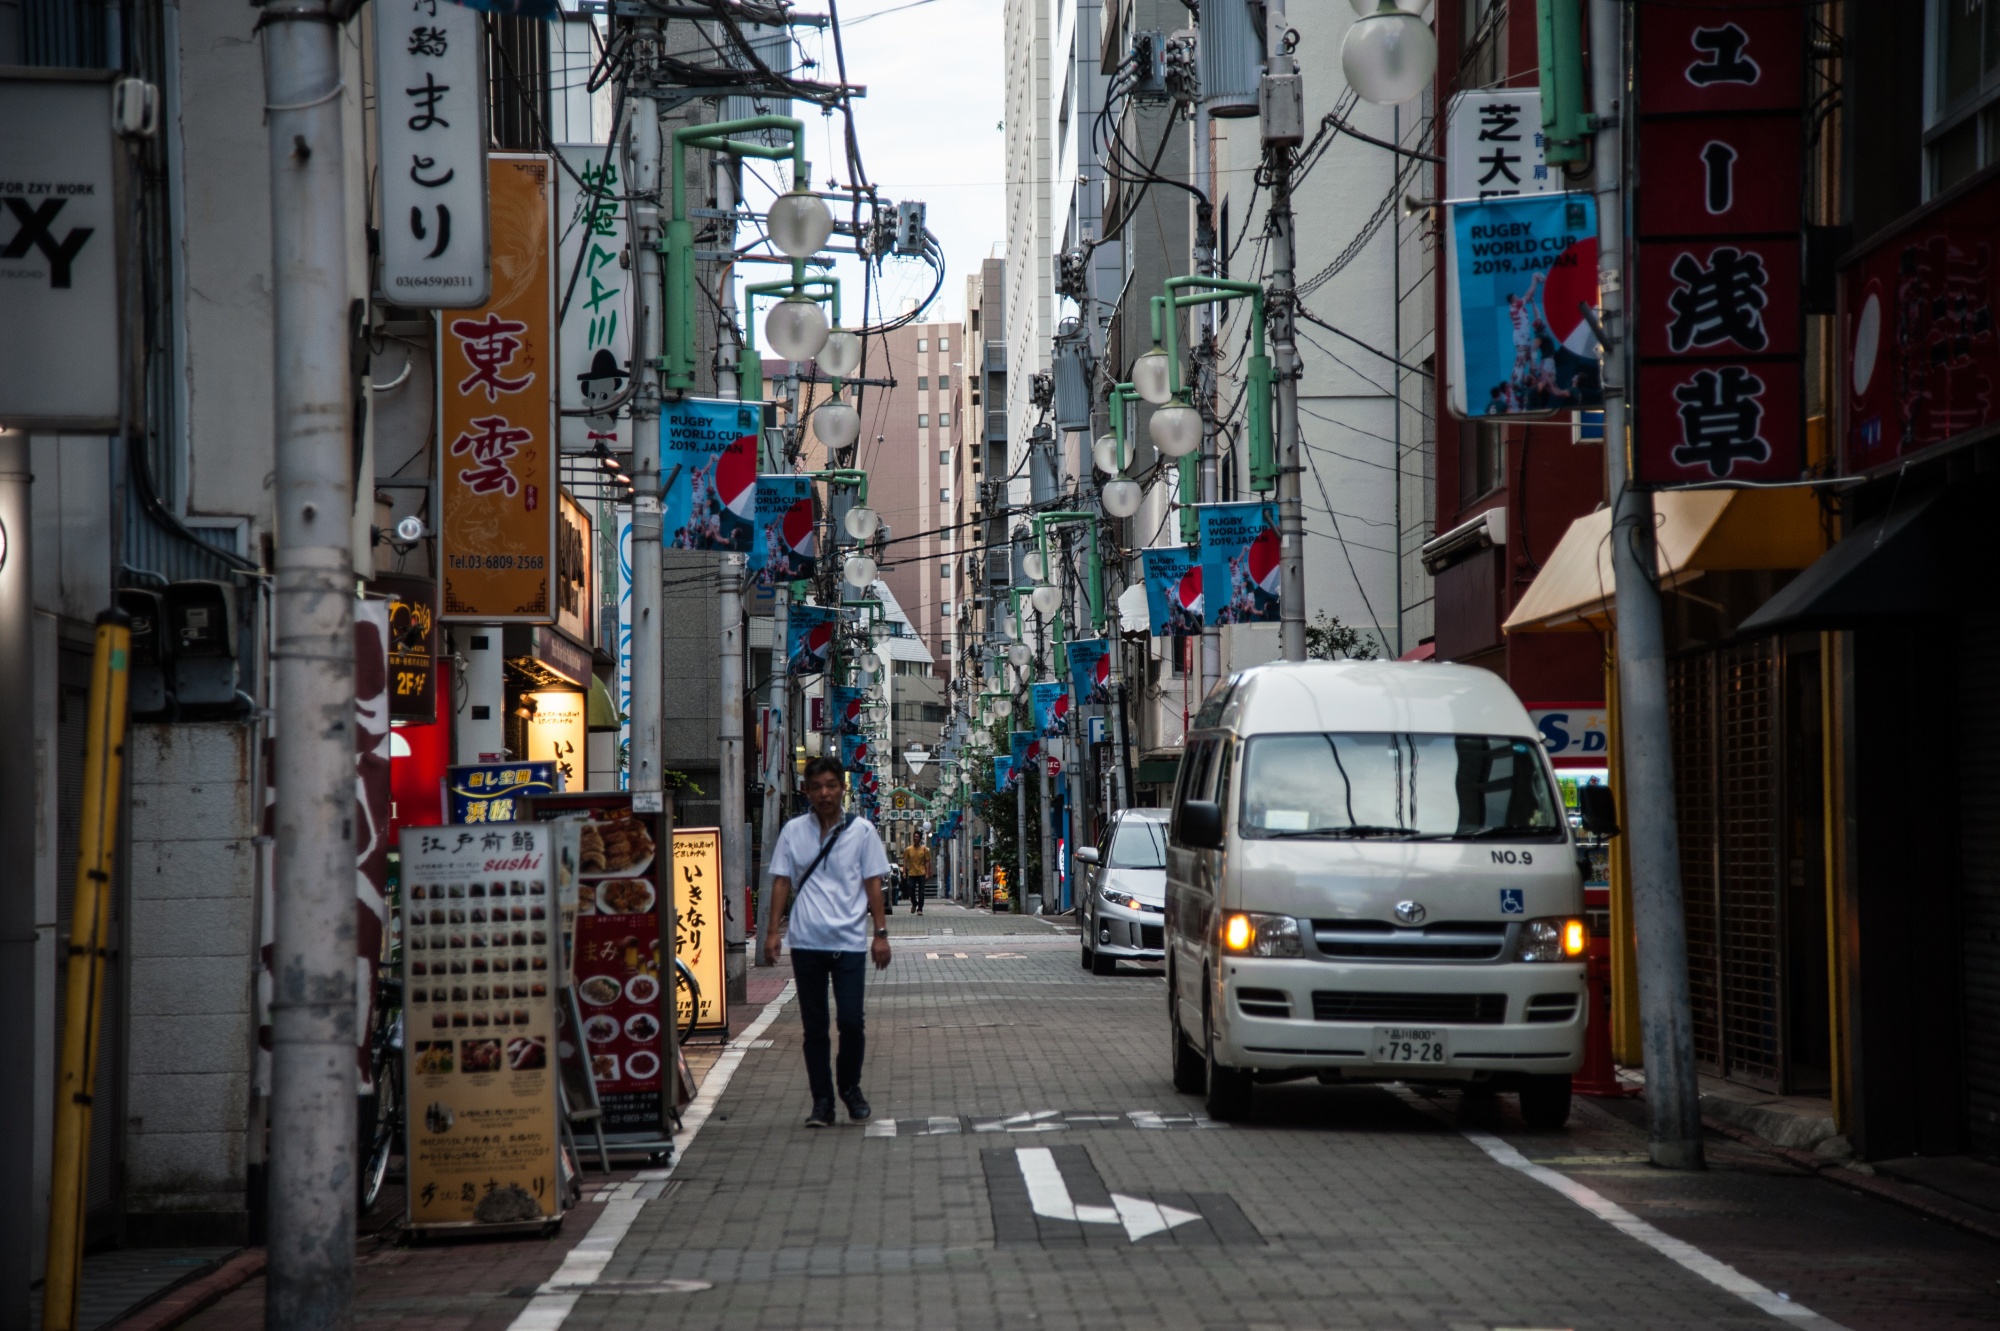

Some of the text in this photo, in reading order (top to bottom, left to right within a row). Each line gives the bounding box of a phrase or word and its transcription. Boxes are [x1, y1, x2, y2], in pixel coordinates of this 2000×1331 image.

[1478, 104, 1522, 199] 芝大
[0, 182, 95, 195] FOR ZXY WORK
[1471, 221, 1532, 239] RUGBY
[1471, 236, 1577, 256] WORLD CUP
[1473, 253, 1578, 275] 2019, JAPAN
[396, 275, 473, 288] 03(6459)0311
[522, 338, 534, 369] トウ
[450, 312, 536, 497] 東雲
[670, 415, 714, 427] RUGBY
[670, 427, 743, 441] WORLD CUP
[669, 439, 743, 454] 2019, JAPAN
[524, 448, 537, 478] ウン
[754, 487, 778, 496] UGBY
[782, 496, 800, 505] CUP
[771, 505, 802, 513] JAPAN
[1208, 516, 1243, 526] RUGBY
[1209, 525, 1268, 536] WORLD CUP
[1209, 535, 1268, 546] 2019, JAPAN
[448, 555, 544, 569] Tel.03-6809-2568
[1178, 563, 1194, 571] CUP
[1150, 572, 1169, 580] 2019,
[1539, 713, 1608, 753] S-D
[464, 797, 516, 824] 浜松
[421, 830, 535, 854] 江戸前鮨
[483, 852, 544, 873] sushi
[1490, 850, 1533, 866] NO.9
[683, 865, 707, 951] いきなり
[1412, 1030, 1431, 1040] 800
[1389, 1042, 1443, 1061] 79-28
